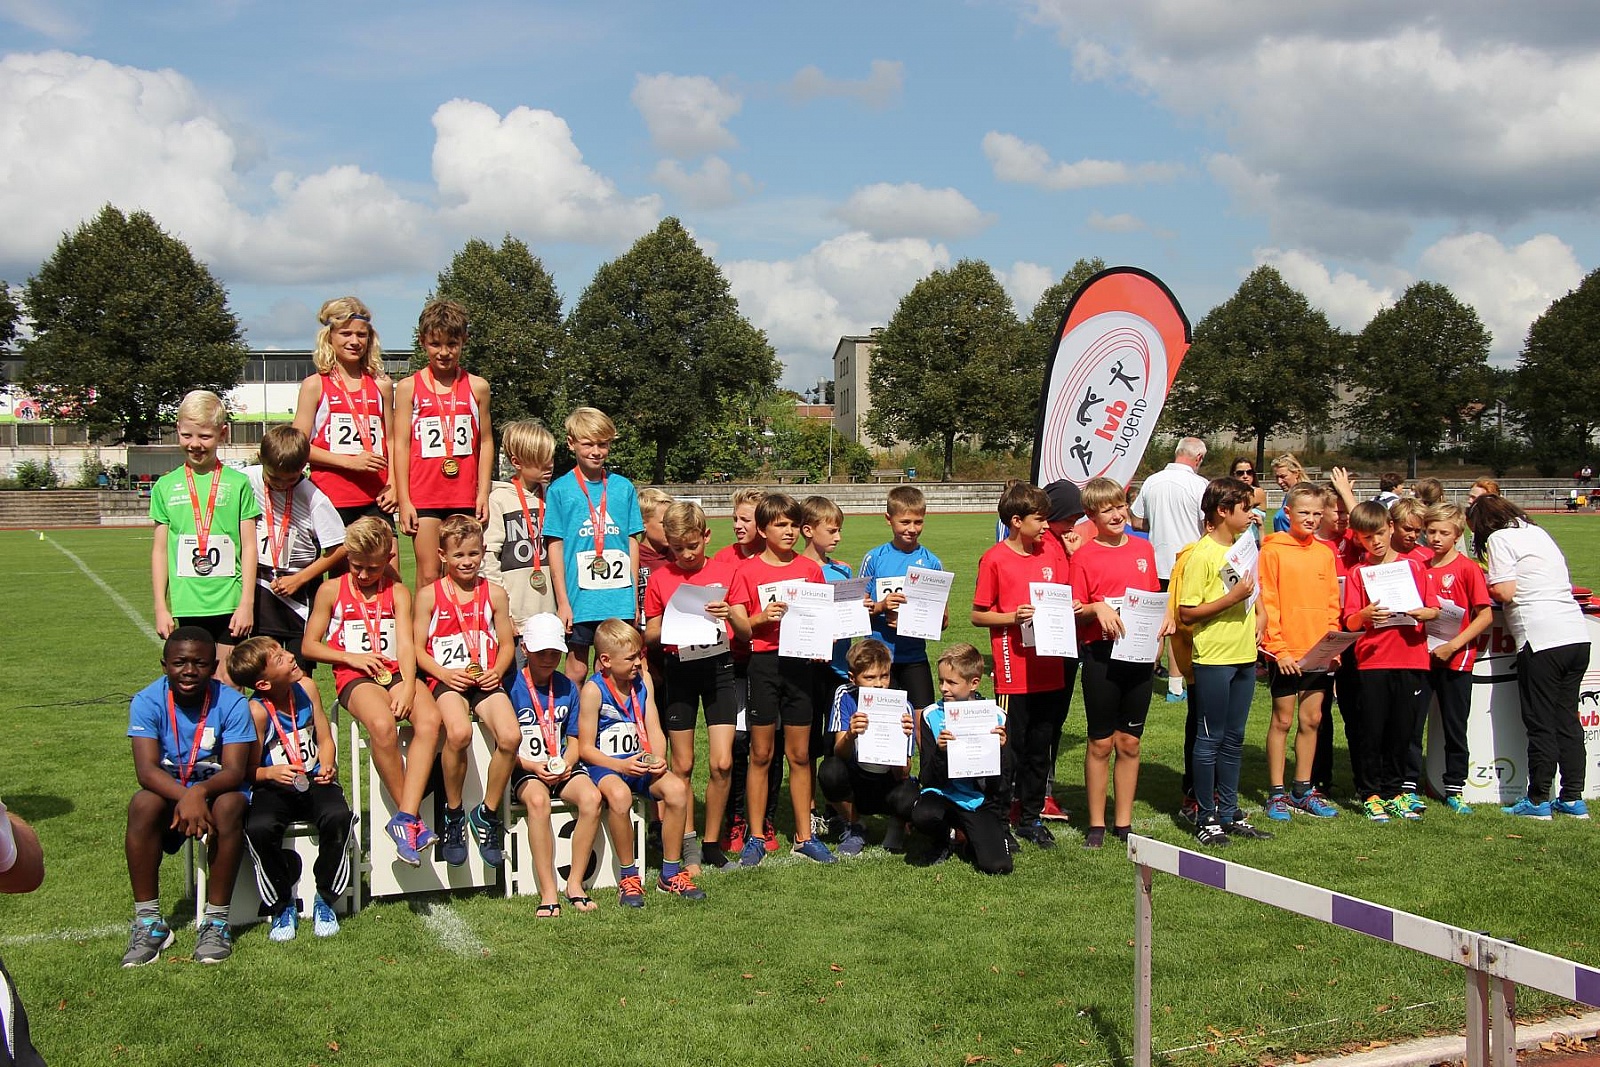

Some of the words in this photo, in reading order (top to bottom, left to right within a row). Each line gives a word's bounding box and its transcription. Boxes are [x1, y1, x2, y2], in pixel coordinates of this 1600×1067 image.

[1095, 400, 1127, 441] lvb
[428, 426, 468, 449] 23
[587, 560, 624, 581] 102
[922, 575, 946, 584] Urkunde
[801, 589, 828, 598] Urkunde
[361, 631, 388, 652] 55
[1474, 627, 1517, 654] vb
[442, 643, 481, 667] 24
[876, 696, 901, 704] Urkunde
[963, 707, 990, 716] Urkunde
[608, 734, 640, 754] 103
